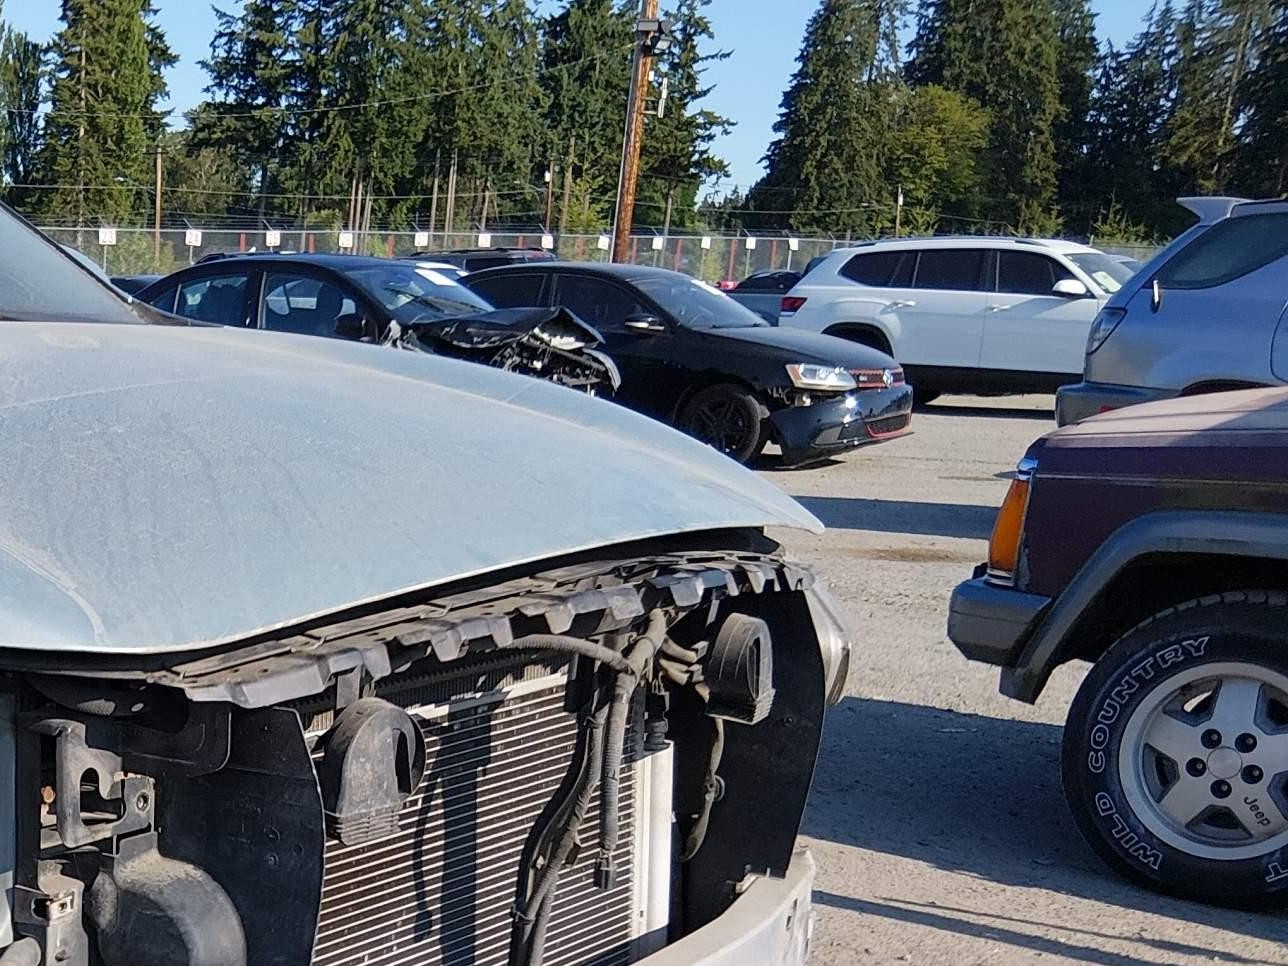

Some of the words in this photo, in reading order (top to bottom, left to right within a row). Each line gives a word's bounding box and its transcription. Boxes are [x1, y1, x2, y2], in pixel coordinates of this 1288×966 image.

[1088, 636, 1210, 774] COUNTRY
[1095, 791, 1164, 871] WILD
[1243, 796, 1271, 827] Jeep
